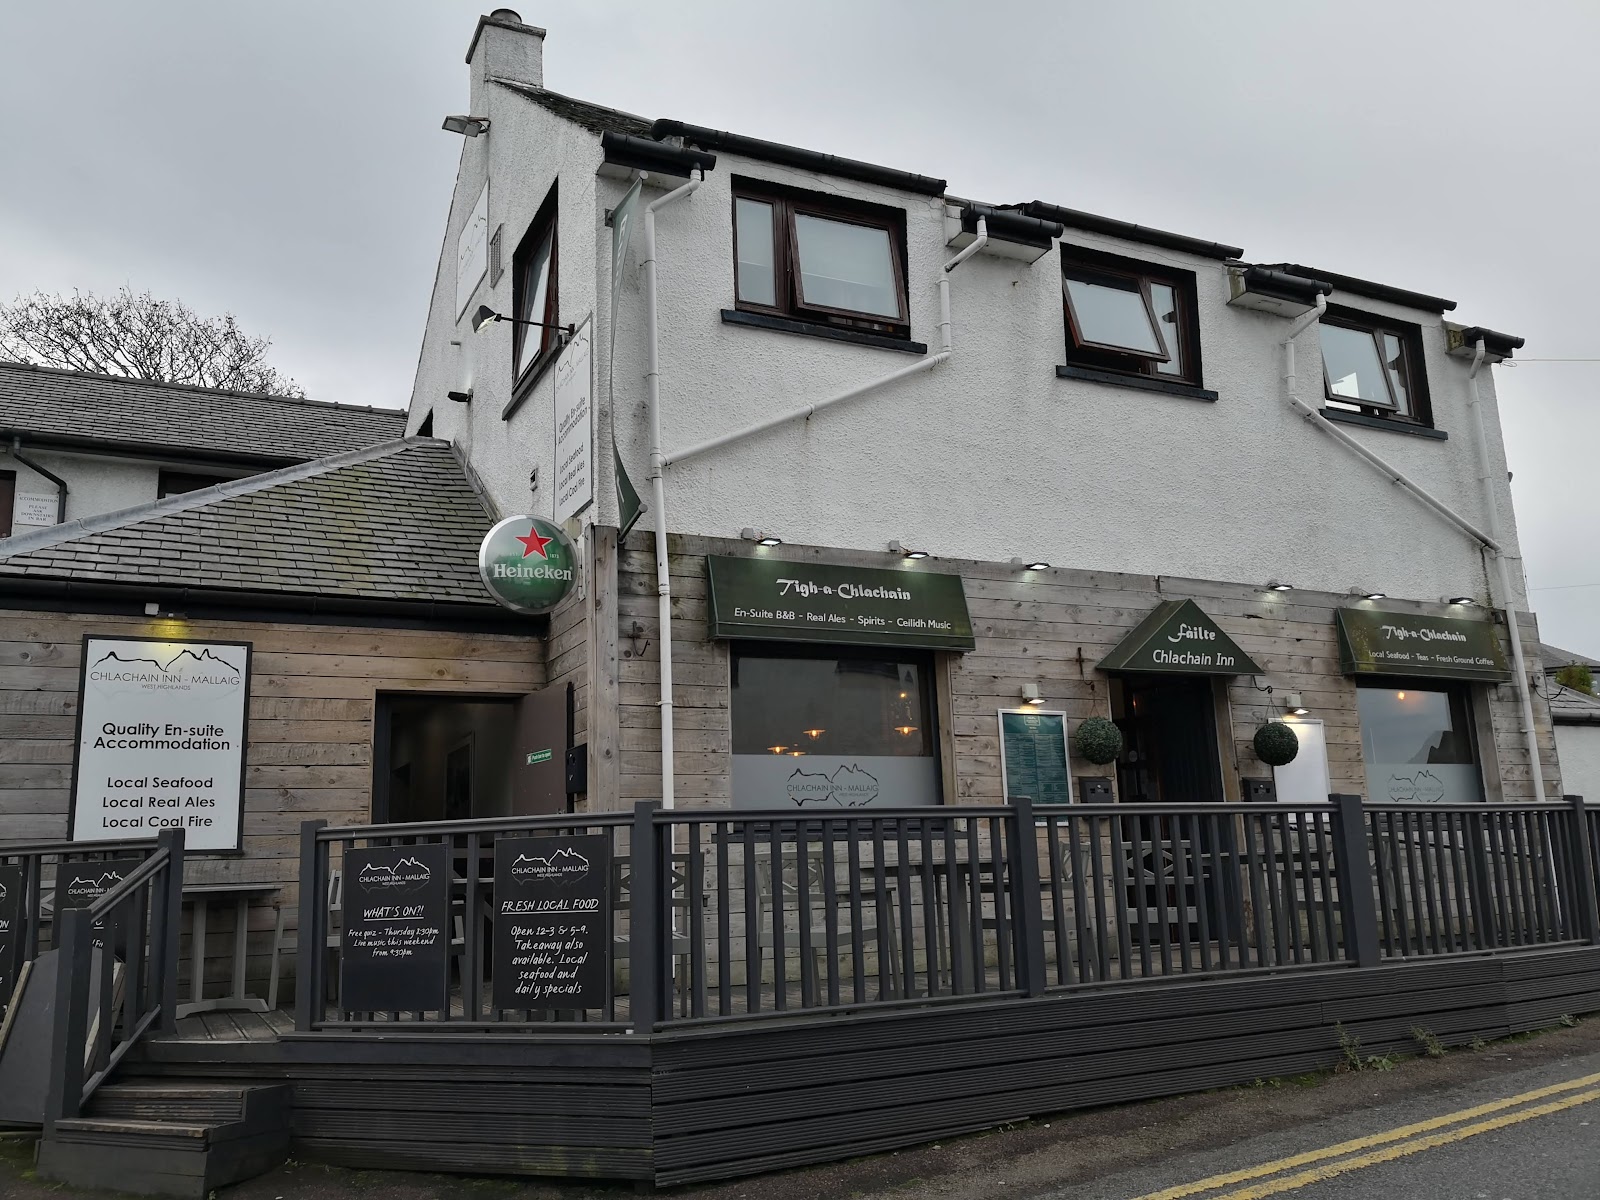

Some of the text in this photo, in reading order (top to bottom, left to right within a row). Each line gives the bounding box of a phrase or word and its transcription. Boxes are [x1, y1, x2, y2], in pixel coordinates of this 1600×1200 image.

[493, 563, 572, 581] Heineken
[775, 578, 911, 601] Tigh-a-Chlachain
[734, 607, 774, 620] En-Suite
[776, 609, 796, 620] B&B
[806, 612, 826, 622] Real
[828, 613, 846, 624] Ales
[858, 615, 886, 627] Spirits
[896, 617, 926, 628] Ceilidh
[928, 619, 951, 629] Music
[1380, 625, 1467, 643] Tigh-a-Chlachain
[1152, 649, 1235, 666] Chlachain Inn
[1386, 650, 1410, 660] Seafood
[1416, 653, 1429, 661] Teas
[1436, 654, 1453, 663] Fresh
[1453, 655, 1475, 665] Ground
[1475, 657, 1494, 666] Coffee
[90, 671, 159, 683] CHLACHAIN
[162, 674, 181, 683] INN
[191, 675, 240, 686] MALLAIG
[102, 722, 224, 738] Quality En-suite
[93, 736, 230, 750] Accommodation
[107, 777, 213, 788] Local Seafood
[786, 784, 828, 792] CHLACHAIN
[830, 784, 842, 792] INN
[848, 784, 879, 792] MALLAIG
[102, 796, 215, 808] Local Real Ales
[102, 816, 213, 828] Local Coal Fire
[511, 866, 546, 874] CHLACHAIN
[561, 864, 589, 873] MALLAIG
[359, 875, 391, 883] CHLACHAIN
[363, 906, 400, 918] WHAT'S
[501, 898, 599, 912] FRESH LOCAL FOOD
[348, 928, 362, 937] Free
[363, 930, 377, 940] quiz
[384, 926, 415, 939] Thursday
[511, 925, 535, 940] Open
[535, 926, 555, 937] 12-3
[558, 925, 568, 935] &
[353, 935, 436, 947] Live music this weekend
[515, 937, 584, 956] Takeaway also
[372, 948, 388, 958] from
[512, 951, 589, 965] available. Local
[517, 965, 579, 981] seafood and
[514, 981, 583, 1000] daily specials
